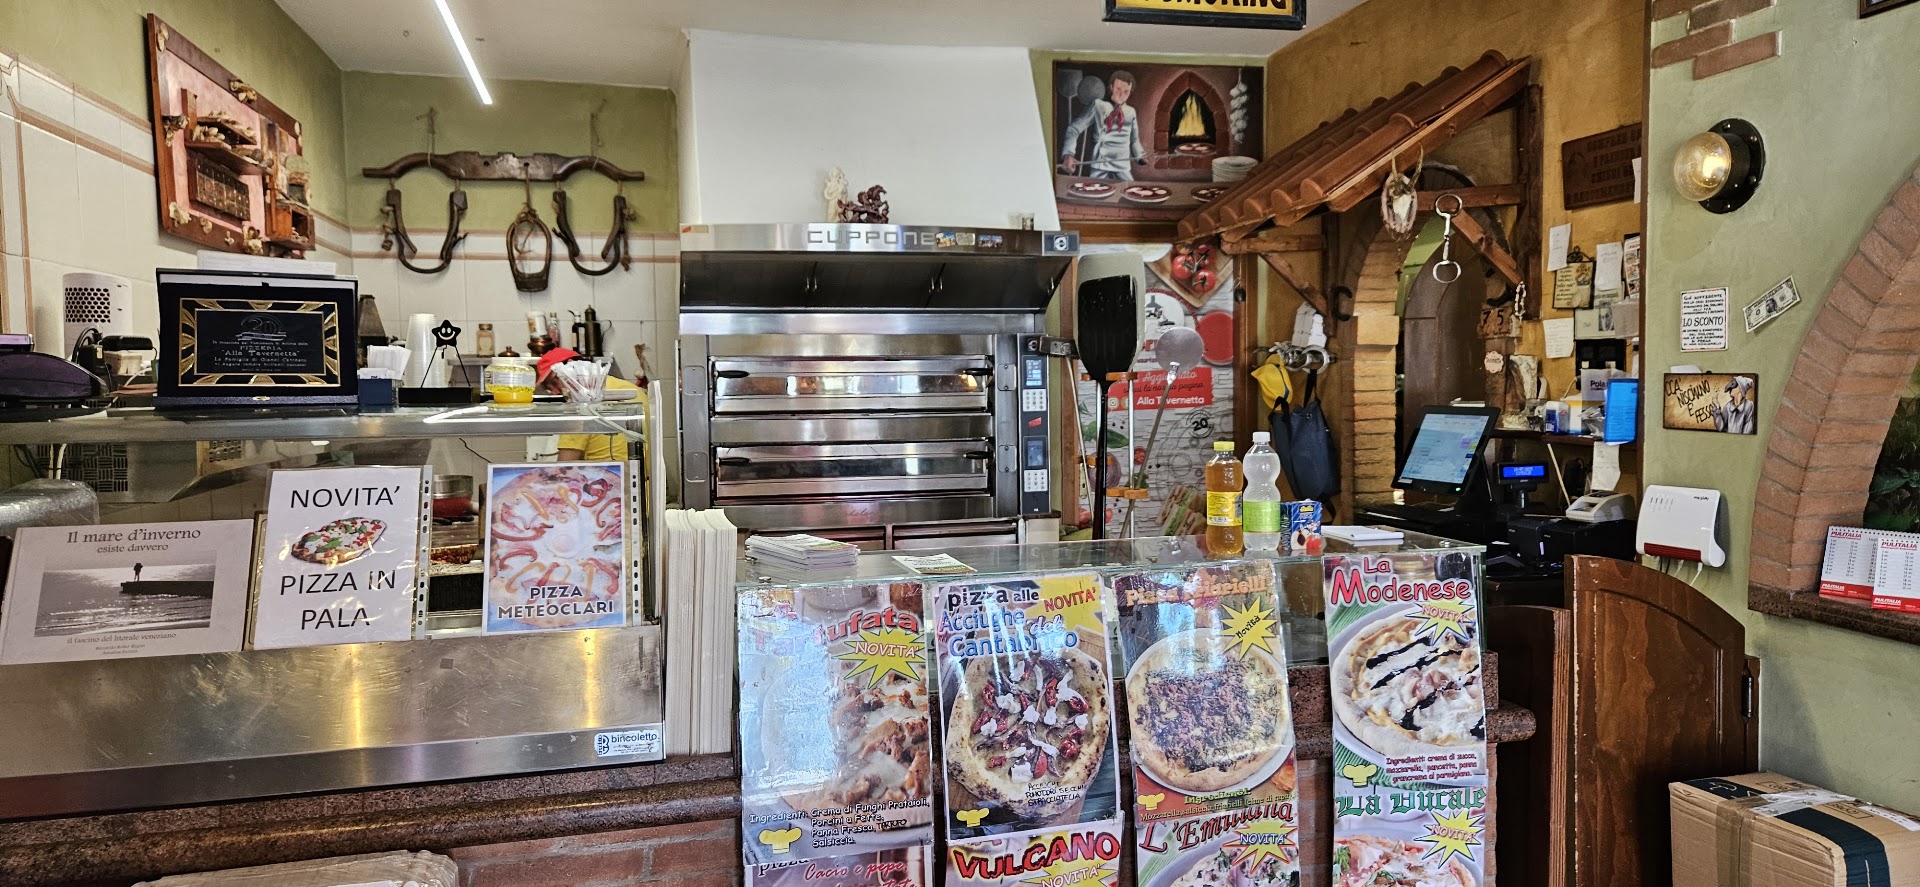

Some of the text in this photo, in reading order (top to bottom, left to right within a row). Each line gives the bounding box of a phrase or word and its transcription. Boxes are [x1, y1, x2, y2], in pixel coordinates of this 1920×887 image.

[808, 231, 935, 245] CUPPONE
[1683, 316, 1723, 327] LO SCONTO
[1137, 396, 1204, 405] Alla Tvernetta
[1192, 418, 1209, 431] 20
[290, 485, 401, 508] NOVITA'
[67, 528, 201, 543] Il mare d'inverno
[97, 543, 168, 553] esiste davvero
[1882, 541, 1917, 549] PULITALIA
[1364, 557, 1391, 573] La
[280, 570, 396, 596] PIZZA IN
[1331, 569, 1472, 604] Modenese
[530, 585, 583, 600] PIZZA
[947, 589, 1039, 612] pizza alle
[1044, 587, 1097, 613] NOVITA'
[498, 601, 613, 619] METEOCLARI
[301, 607, 370, 630] PALA
[939, 607, 1025, 633] Acciughe
[751, 607, 920, 655] Tatufata
[74, 637, 100, 645] fascino
[950, 632, 1078, 657] Cantabrico
[855, 641, 920, 658] NOVITA'
[611, 733, 657, 743] bincoletto
[1386, 756, 1426, 766] Ingredienti:
[1427, 763, 1457, 772] pancetta,
[1459, 761, 1477, 771] panna
[749, 798, 931, 825] Ingredienti: Crema di Funghi Prataioli,
[811, 815, 846, 827] Porcini
[854, 813, 885, 823] Fette,
[876, 818, 908, 832] TARTUFO
[811, 822, 876, 838] Panna Fresca,
[812, 837, 857, 849] Salsiccia.
[1240, 833, 1288, 845] NOVITA'
[953, 831, 1121, 879] VULCANO
[804, 863, 848, 881] Cacio
[866, 862, 908, 880] pepe,
[1041, 863, 1101, 887] NOVITA'
